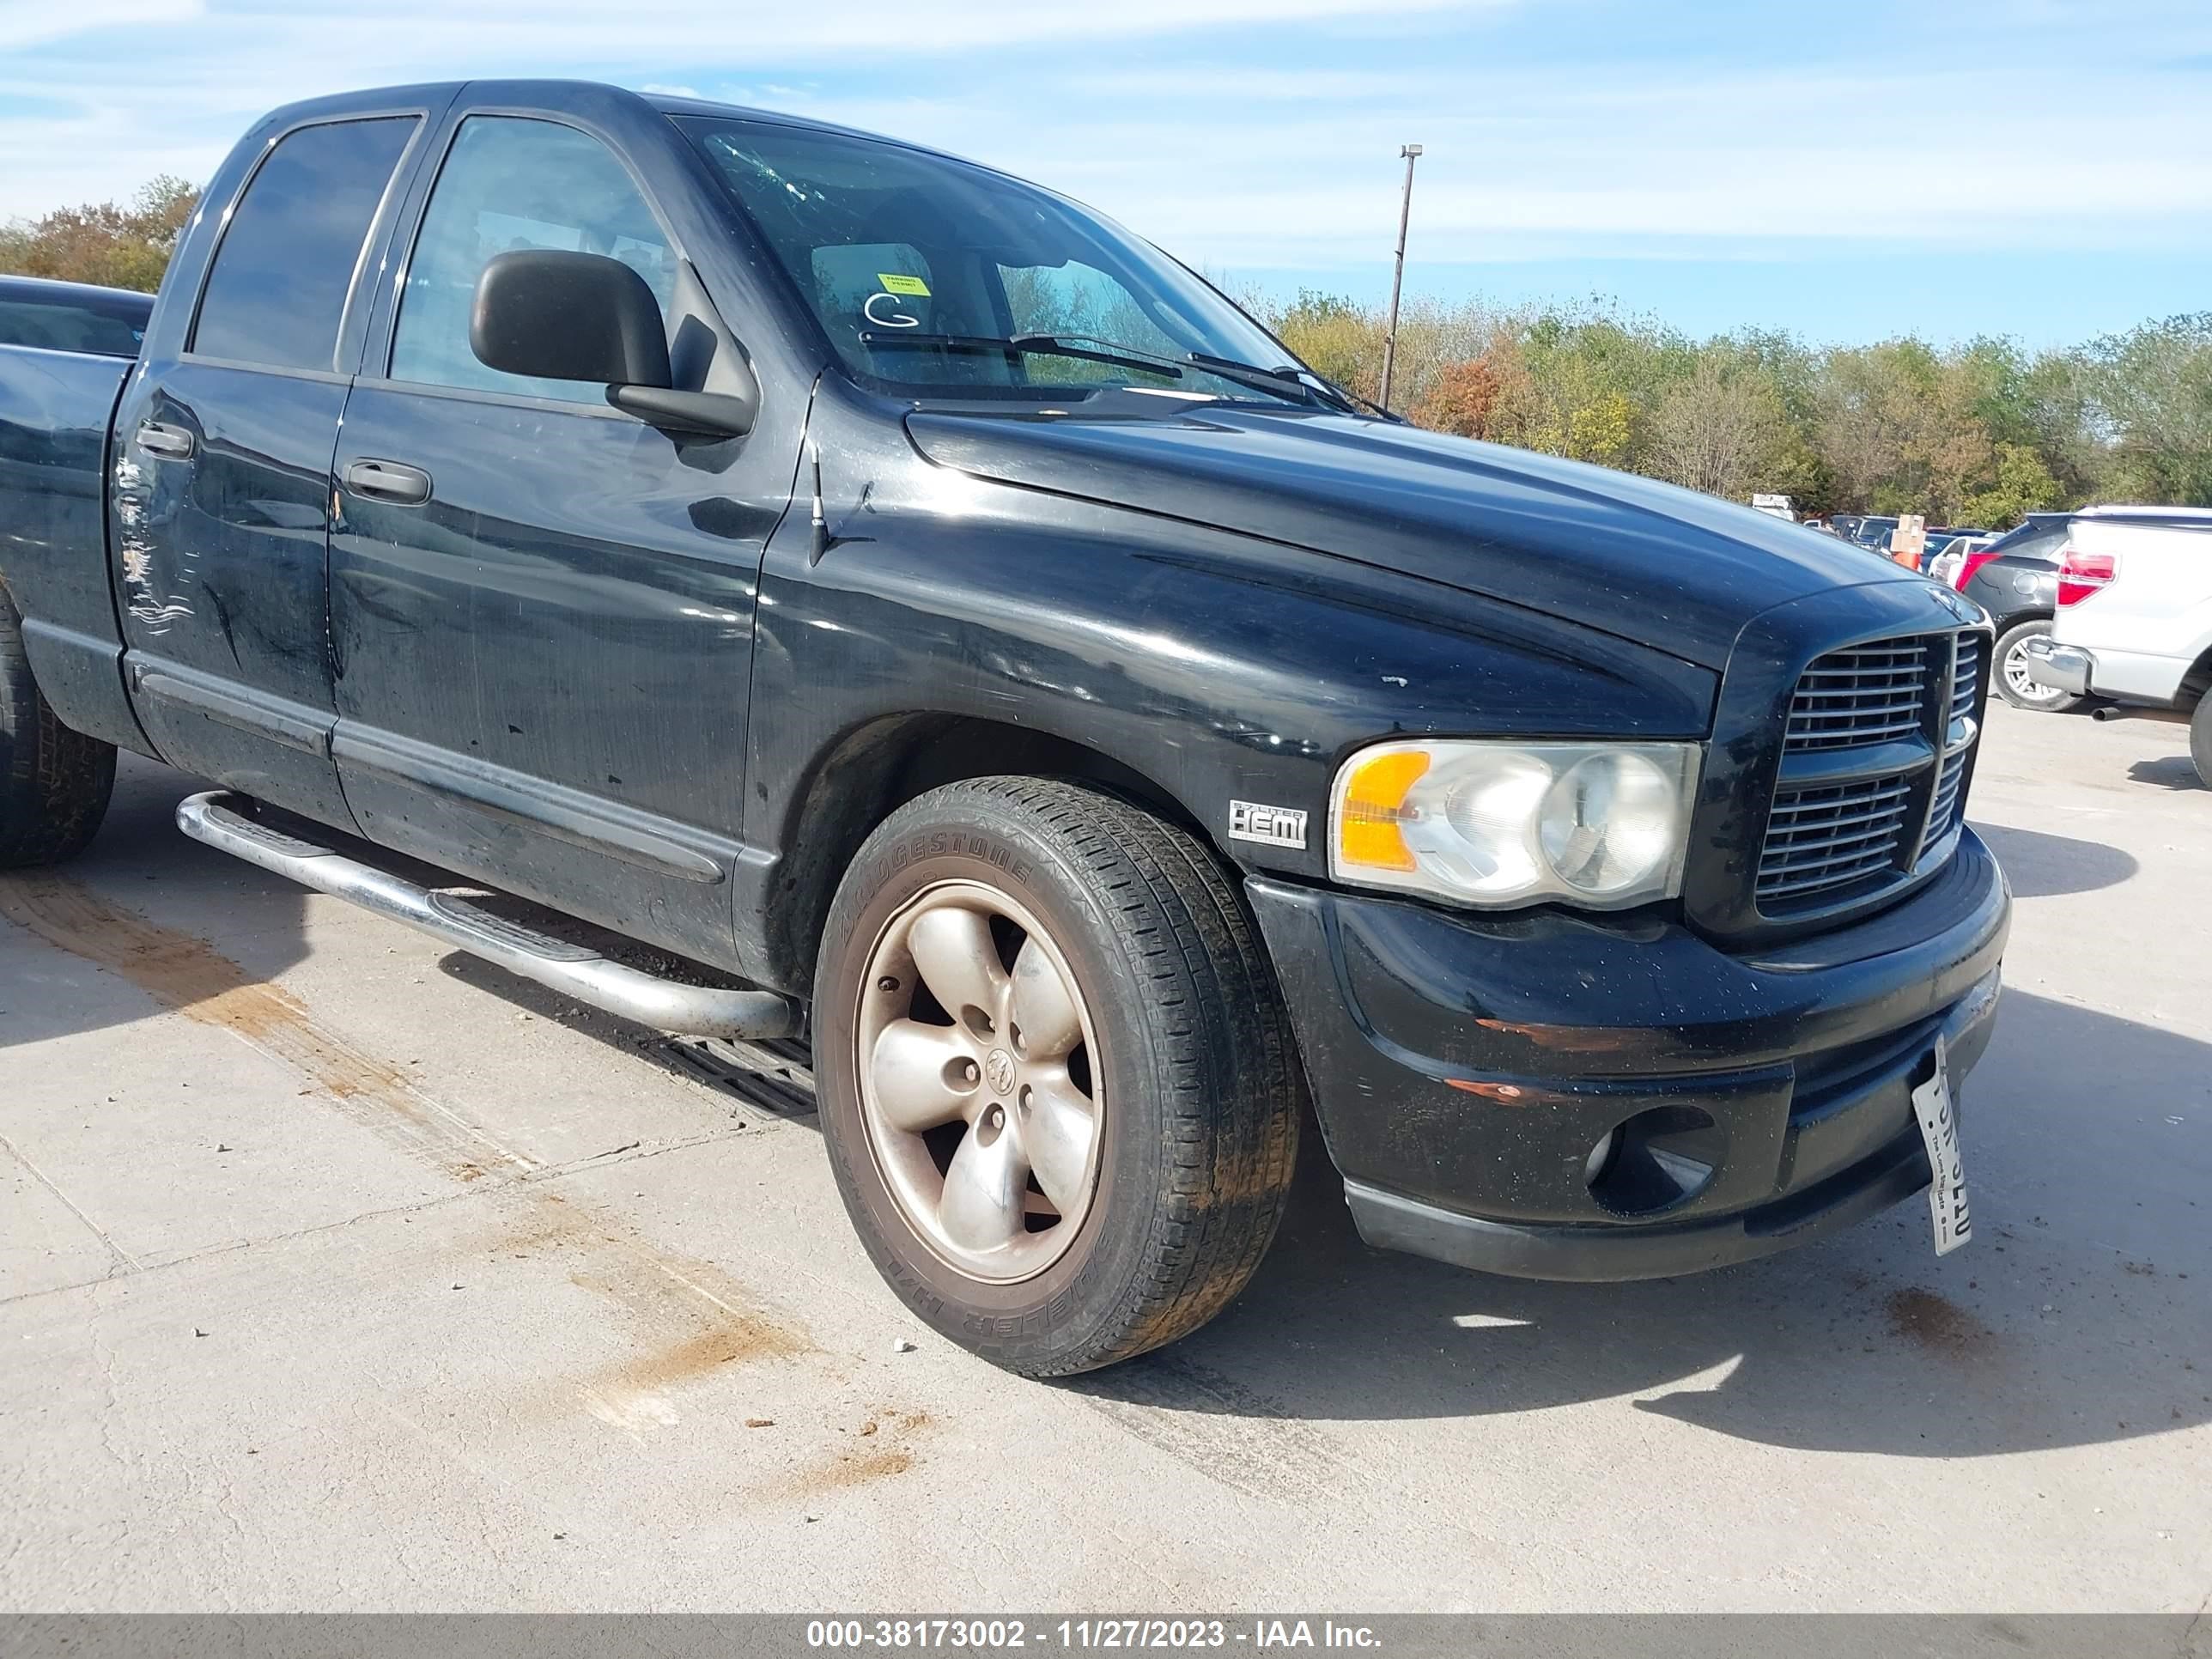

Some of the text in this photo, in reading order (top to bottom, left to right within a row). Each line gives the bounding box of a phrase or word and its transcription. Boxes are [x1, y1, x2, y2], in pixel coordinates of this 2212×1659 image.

[864, 293, 920, 328] G
[1229, 805, 1308, 842] HEMI
[1258, 806, 1304, 819] LITER
[838, 831, 1033, 948] BRIDGESTONE
